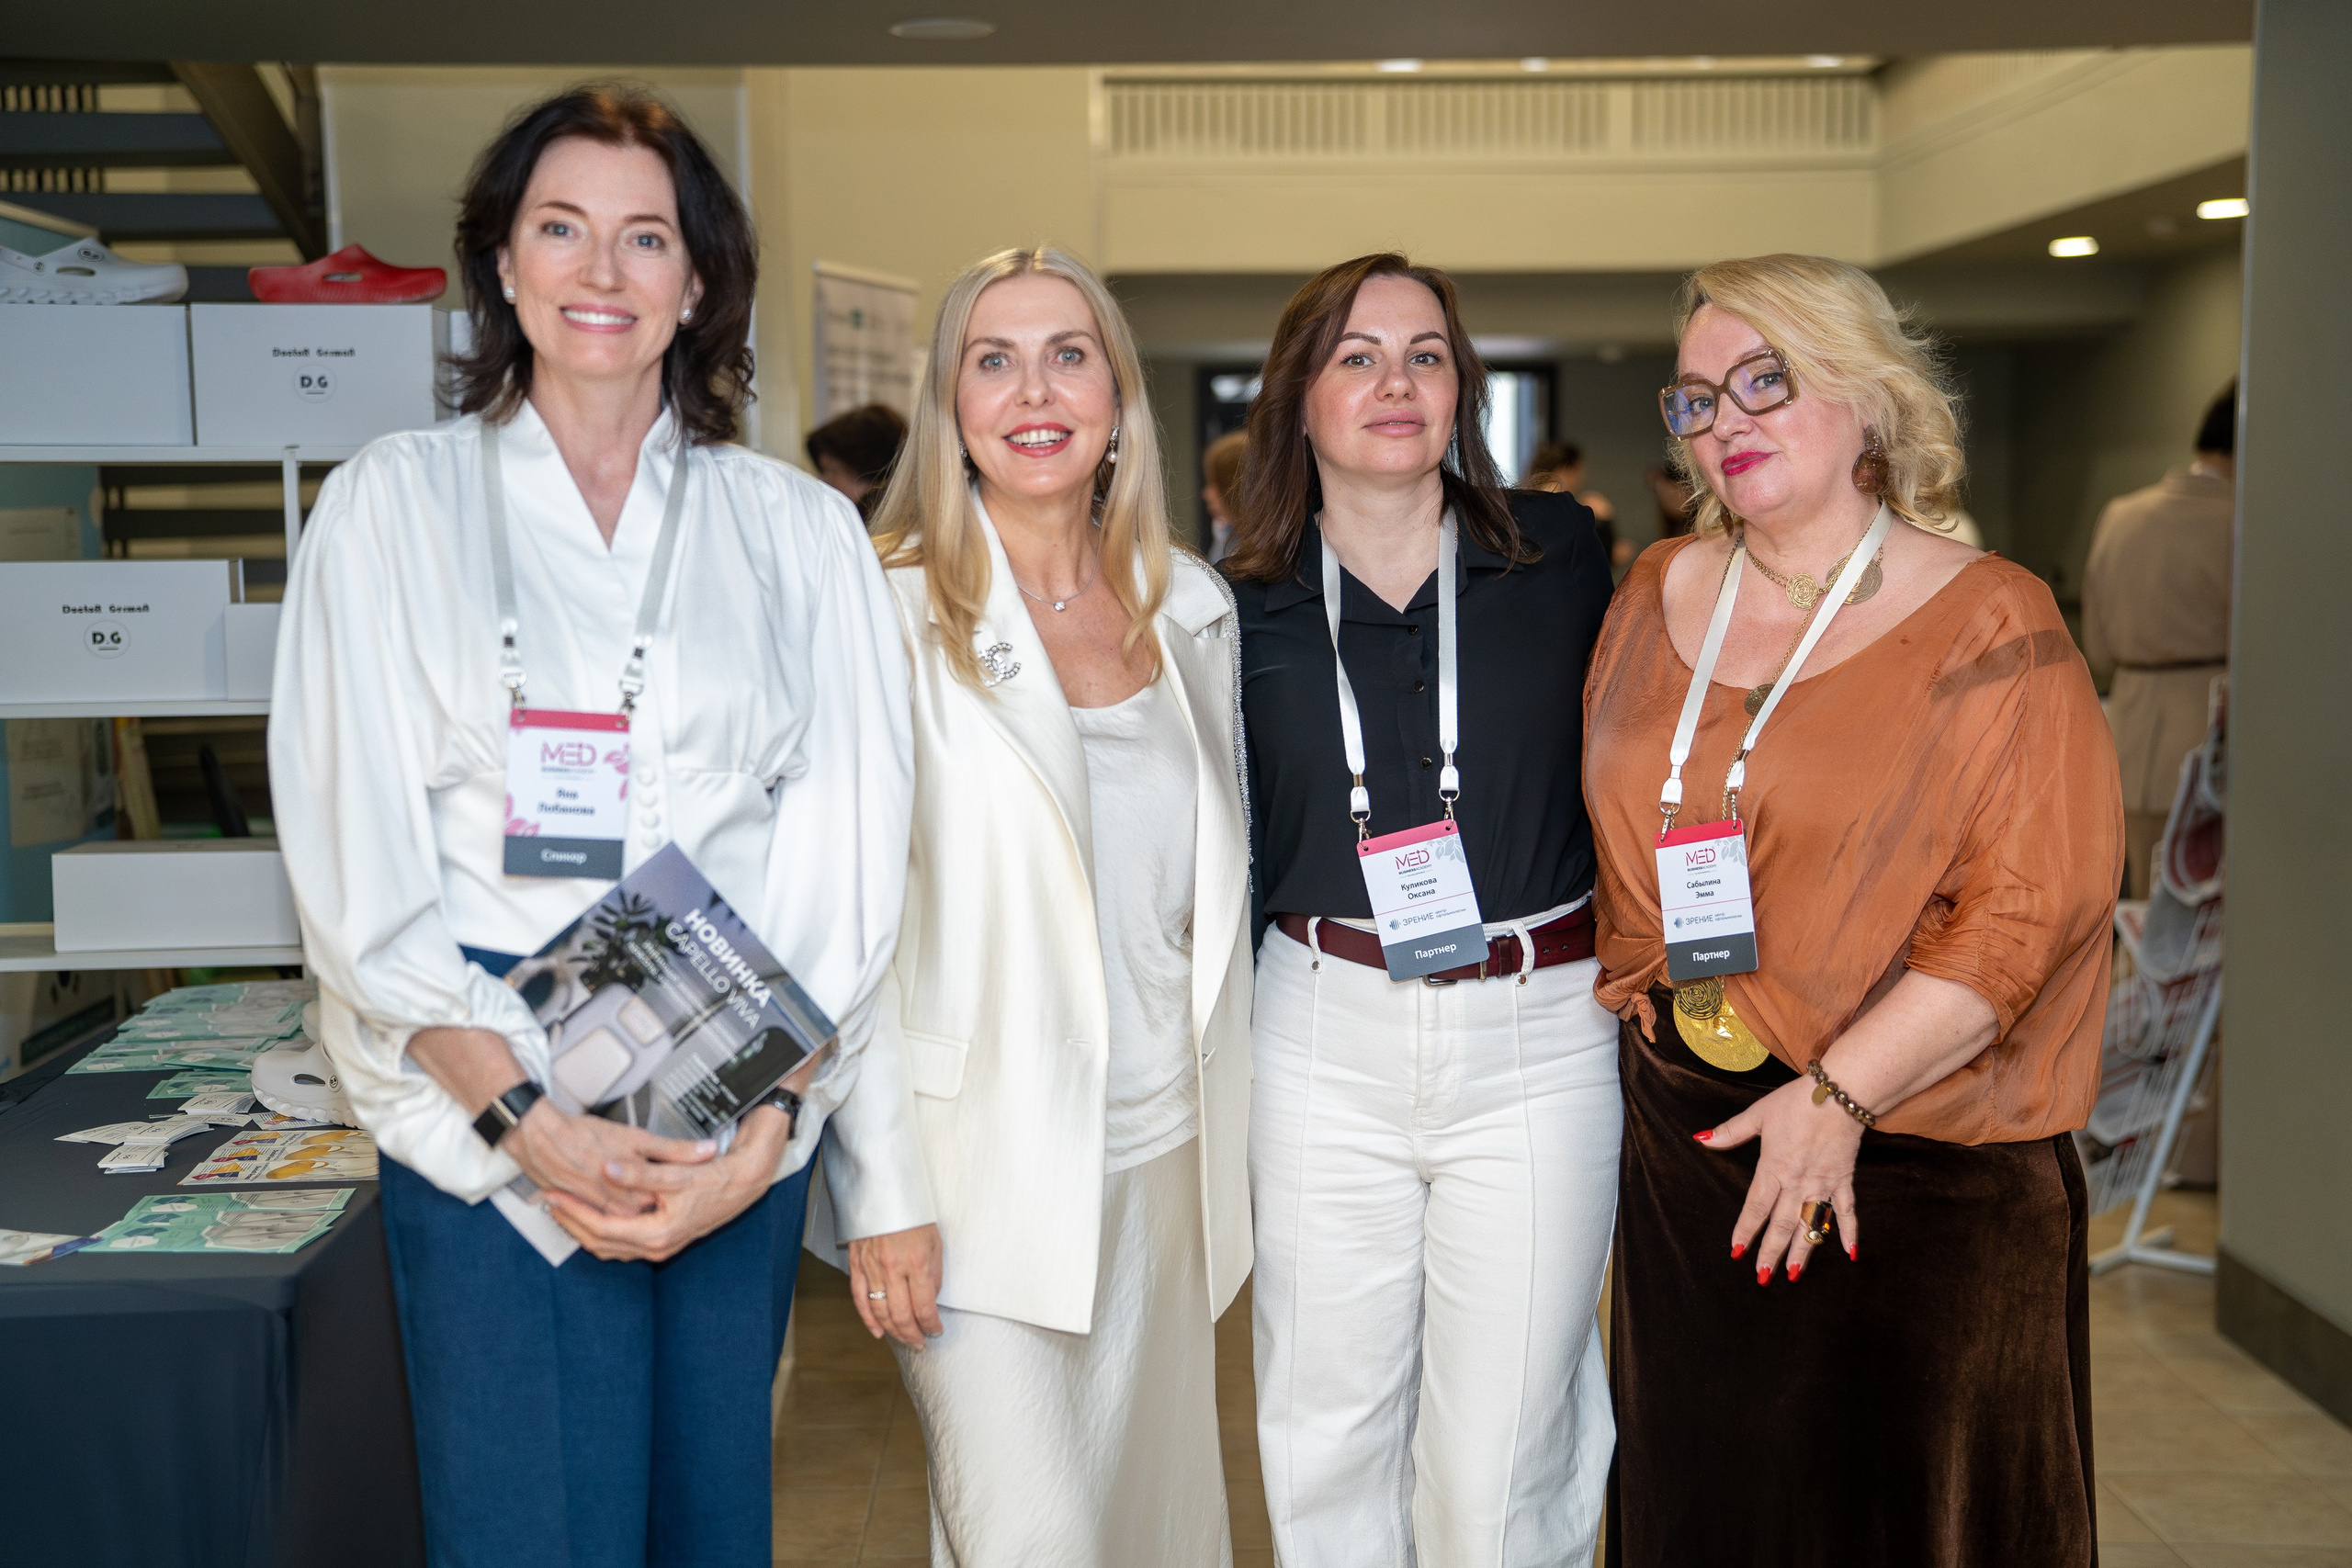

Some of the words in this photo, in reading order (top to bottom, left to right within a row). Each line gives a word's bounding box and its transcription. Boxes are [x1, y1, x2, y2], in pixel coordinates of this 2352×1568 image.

[540, 741, 597, 767] MED
[1395, 850, 1430, 870] MED
[1686, 847, 1716, 866] MED
[1400, 877, 1438, 891] Куликова
[1686, 878, 1721, 889] Сабылина
[1408, 888, 1436, 900] Оксана
[1695, 890, 1714, 899] Эмма
[1402, 912, 1435, 926] ЗРЕНИЕ
[1685, 914, 1713, 926] ЗРЕНИЕ
[1415, 943, 1457, 959] Партнер
[1692, 950, 1730, 963] Партнер
[684, 908, 772, 1010] НОВИНКА
[664, 921, 730, 994] CAPELLO
[726, 987, 761, 1030] VIVA
